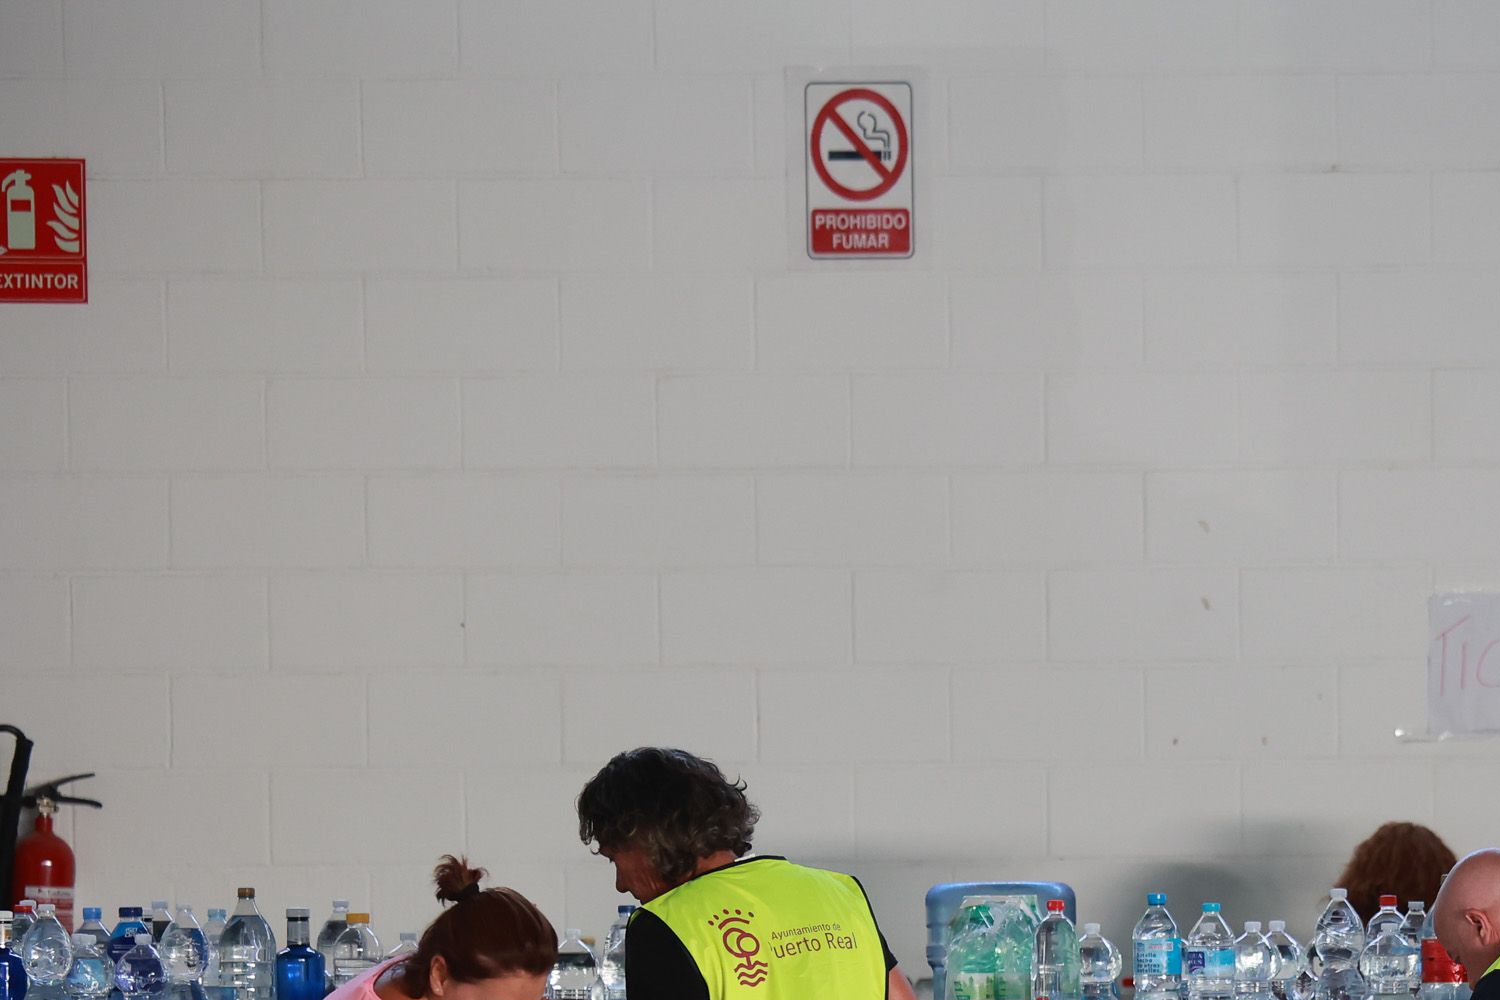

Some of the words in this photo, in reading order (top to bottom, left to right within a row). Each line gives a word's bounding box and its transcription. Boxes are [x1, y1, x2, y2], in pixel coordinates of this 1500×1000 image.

[815, 213, 906, 230] PROHIBIDO
[832, 233, 890, 250] FUMAR
[770, 923, 831, 941] Ayuntamiento
[825, 932, 858, 950] Real
